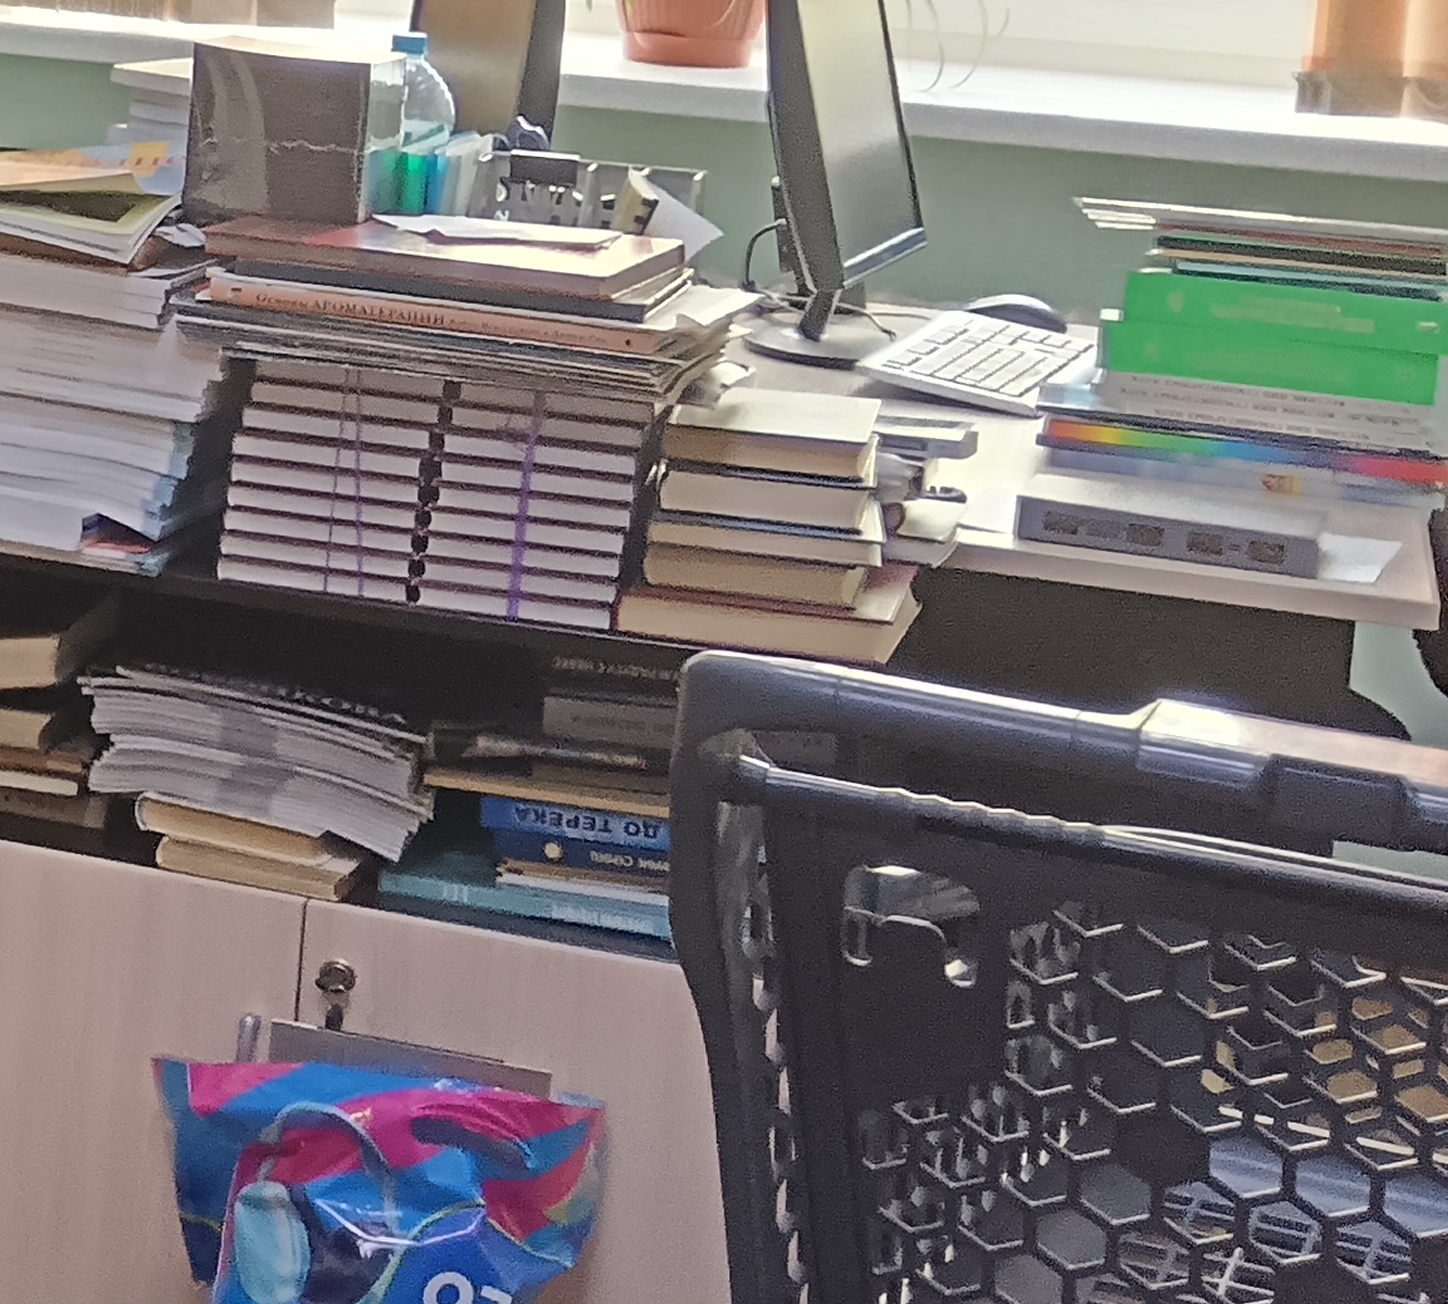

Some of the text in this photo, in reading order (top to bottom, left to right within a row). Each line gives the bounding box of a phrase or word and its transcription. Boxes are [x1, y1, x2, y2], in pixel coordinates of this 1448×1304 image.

[311, 297, 446, 327] АРОМАТЕРАПИИ
[513, 803, 662, 840] ДО ТЕРЕКА
